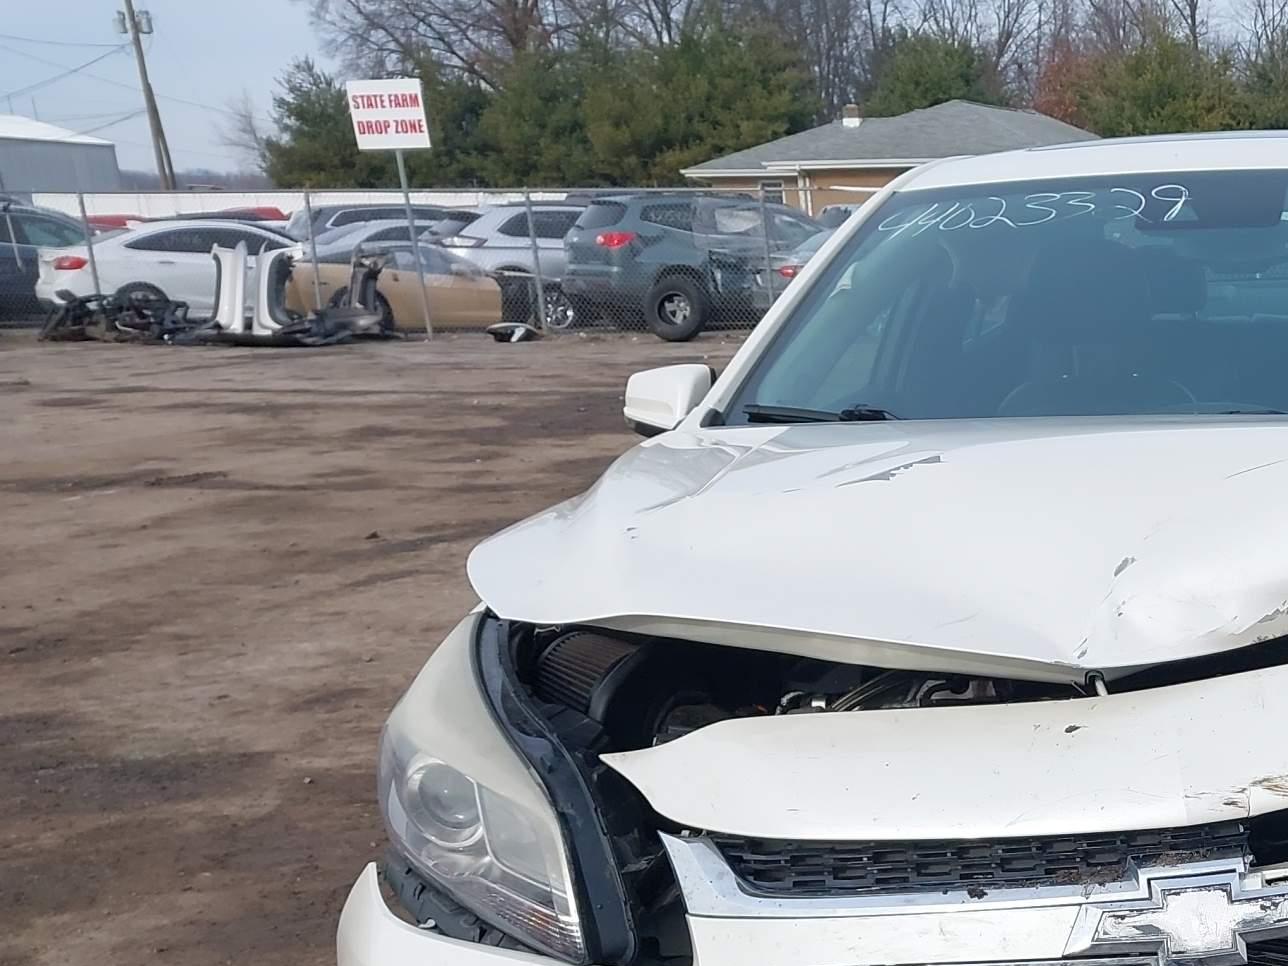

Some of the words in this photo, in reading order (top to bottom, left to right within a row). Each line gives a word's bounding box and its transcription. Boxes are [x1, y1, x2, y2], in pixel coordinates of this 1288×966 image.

[352, 94, 386, 109] STATE
[387, 93, 420, 108] FARM
[357, 120, 391, 135] DROP
[393, 119, 425, 134] ZONE
